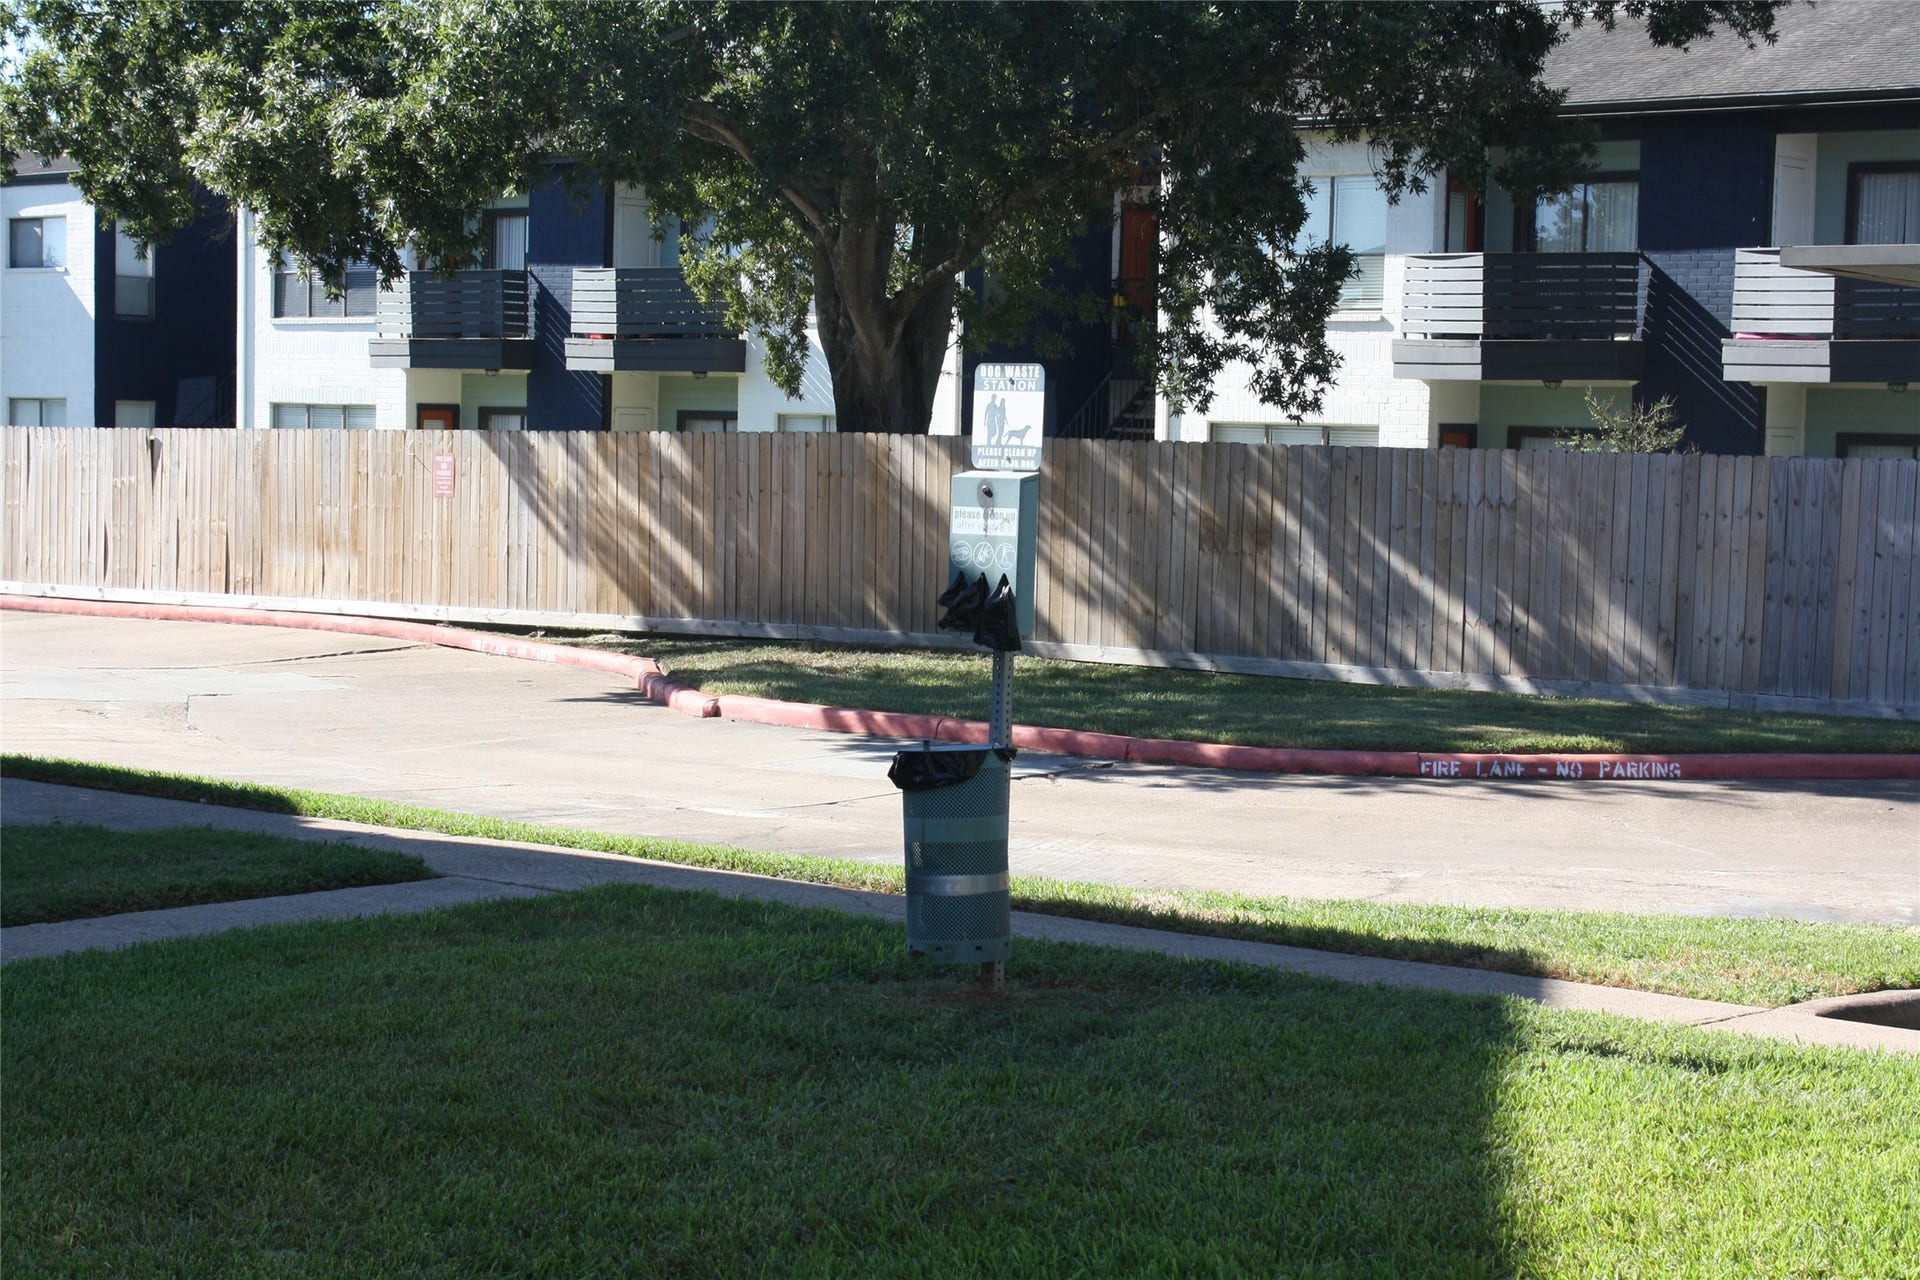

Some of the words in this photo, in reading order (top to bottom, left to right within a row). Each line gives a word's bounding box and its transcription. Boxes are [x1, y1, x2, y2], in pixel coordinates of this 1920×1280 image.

[980, 365, 1001, 378] DOG
[1004, 365, 1040, 378] WASTE
[983, 380, 1036, 391] STATION
[977, 447, 1002, 457] PLEASE
[1004, 447, 1026, 457] CLEAN
[1027, 448, 1037, 458] UP
[978, 458, 999, 468] AFTER
[954, 508, 981, 520] please
[1556, 761, 1582, 777] NO
[1599, 761, 1681, 778] PARKING
